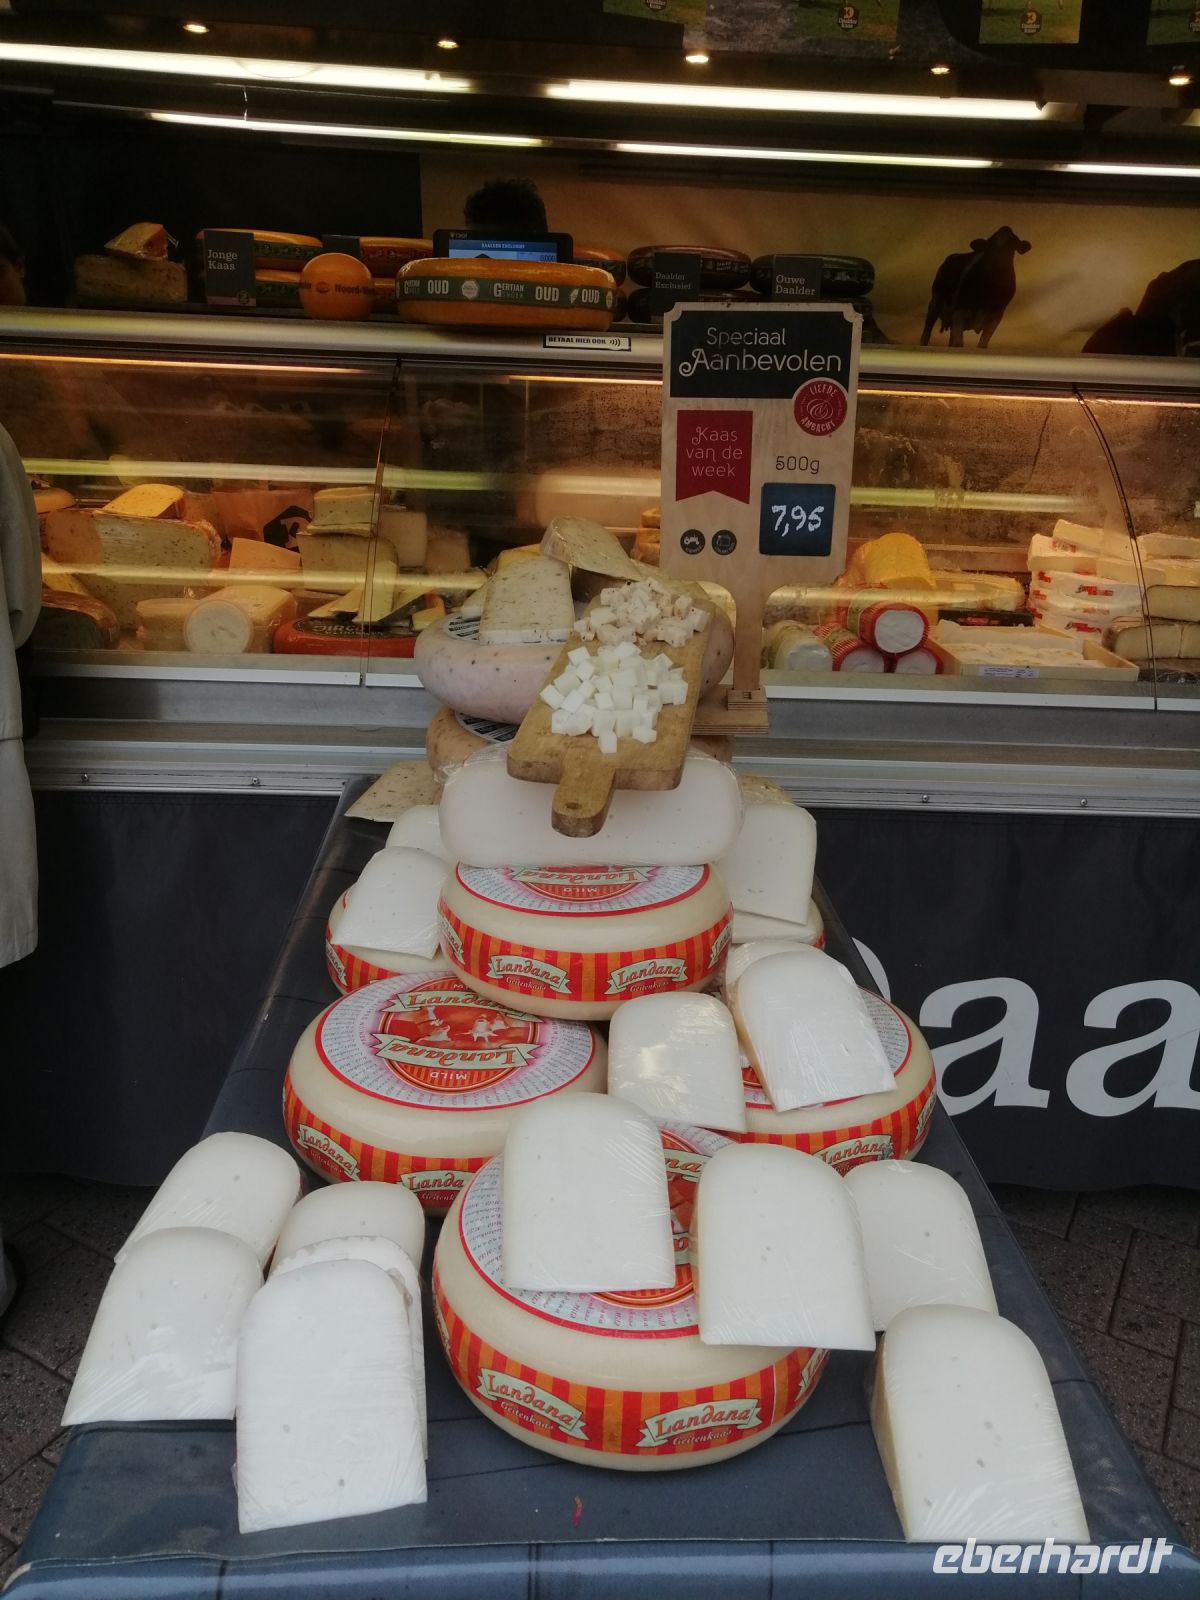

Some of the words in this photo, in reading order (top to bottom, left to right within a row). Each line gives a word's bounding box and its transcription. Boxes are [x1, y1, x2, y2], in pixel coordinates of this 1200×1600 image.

[208, 249, 238, 262] Jonge
[208, 260, 236, 270] Kaas
[655, 271, 685, 281] Daalder
[776, 274, 805, 284] Ouwe
[427, 279, 450, 294] OUD
[535, 286, 560, 302] OUD
[776, 284, 816, 296] Daalder
[582, 289, 601, 304] OUD
[706, 327, 788, 348] Speciaal
[679, 347, 843, 377] Aanbevolen
[810, 383, 839, 397] LIEFDE
[800, 416, 836, 433] AMBACHT
[691, 426, 739, 446] Kaas
[685, 446, 717, 463] van
[722, 446, 743, 460] de
[691, 463, 736, 477] week
[775, 455, 820, 475] 500g
[771, 504, 825, 537] 7,95
[520, 870, 638, 884] Landana
[495, 958, 561, 984] Landana
[616, 960, 681, 983] Landana
[389, 1043, 517, 1066] Landana
[430, 1071, 467, 1080] MILD
[302, 1128, 353, 1169] Landana
[487, 1374, 574, 1425] Landana
[500, 1401, 554, 1430] Geitenkaas
[655, 1404, 751, 1438] Landana
[672, 1430, 733, 1446] Geitenkaas
